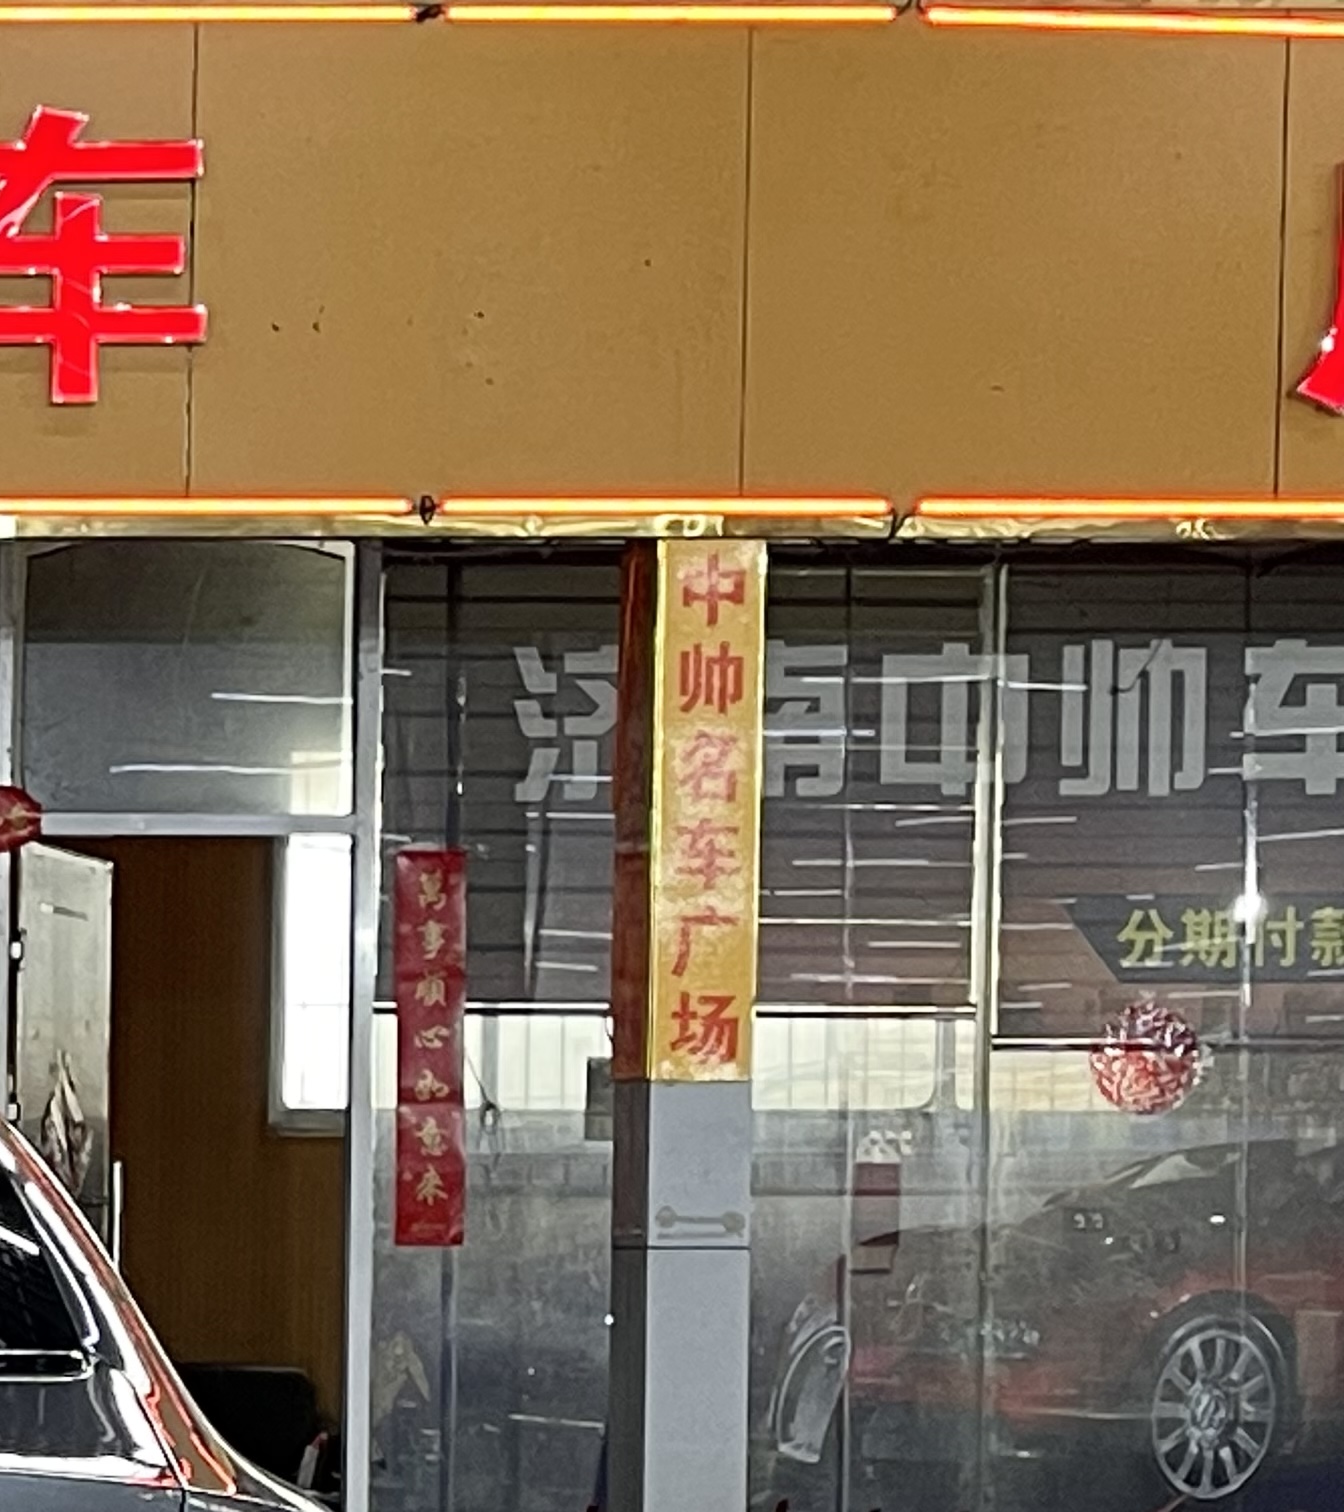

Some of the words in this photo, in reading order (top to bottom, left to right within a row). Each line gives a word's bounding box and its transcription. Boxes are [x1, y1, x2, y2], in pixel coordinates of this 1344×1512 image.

[670, 553, 746, 1064] 中帅名车广场
